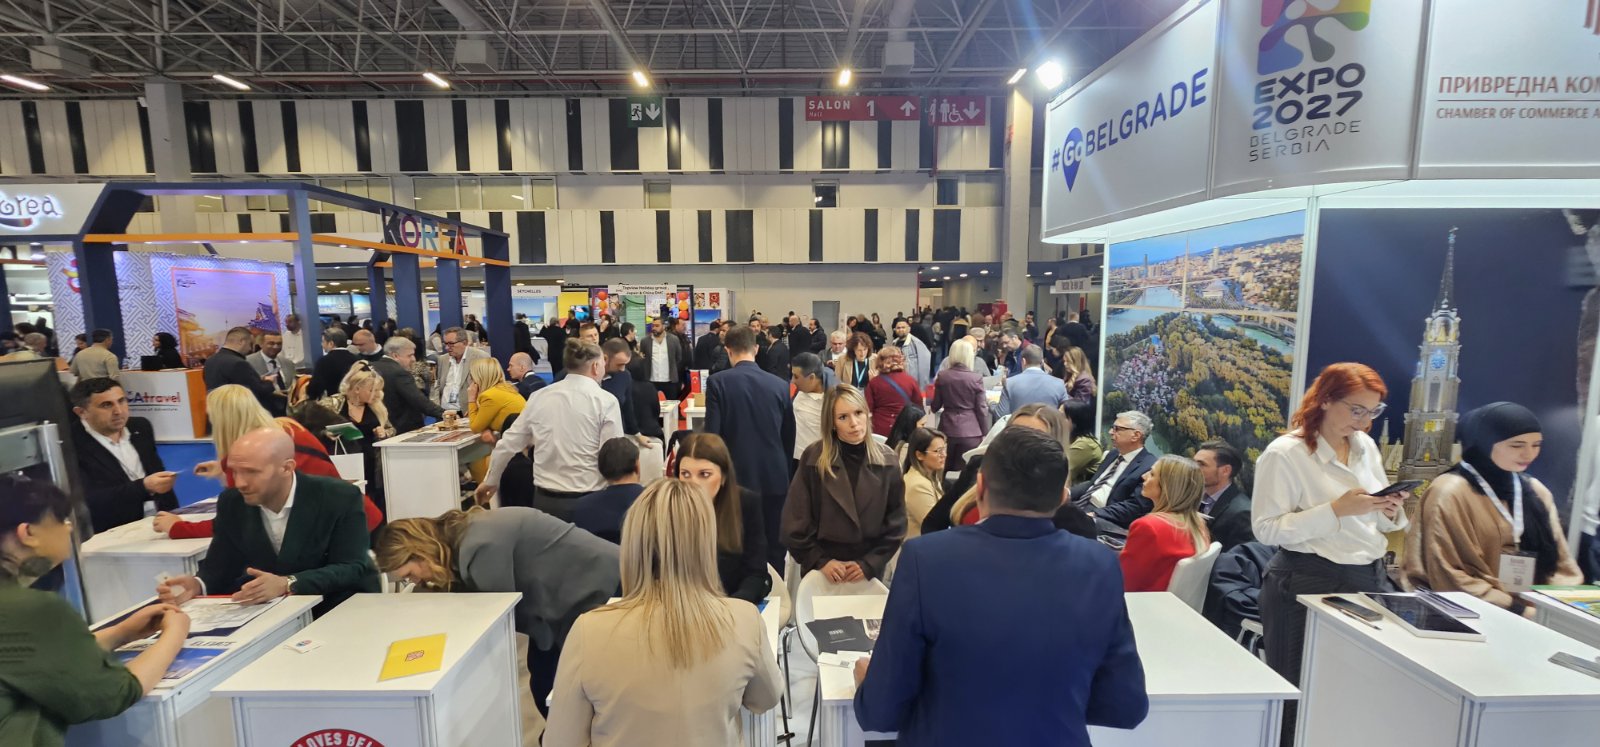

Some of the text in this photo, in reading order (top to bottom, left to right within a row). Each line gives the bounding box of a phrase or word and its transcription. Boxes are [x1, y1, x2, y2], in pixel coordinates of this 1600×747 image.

[1254, 63, 1366, 105] EXPO
[1439, 76, 1559, 97] ПРИВРЕДНА
[808, 99, 875, 117] SALON 1
[1252, 90, 1363, 130] 2027
[1436, 107, 1497, 119] CHAMBER
[1500, 107, 1516, 119] OF
[1519, 107, 1589, 119] COMMERCE
[1250, 120, 1361, 147] BELGRADE
[1249, 139, 1330, 162] SERBIA
[0, 195, 59, 216] orea
[381, 208, 469, 256] KOREA
[126, 391, 181, 403] CAtravel
